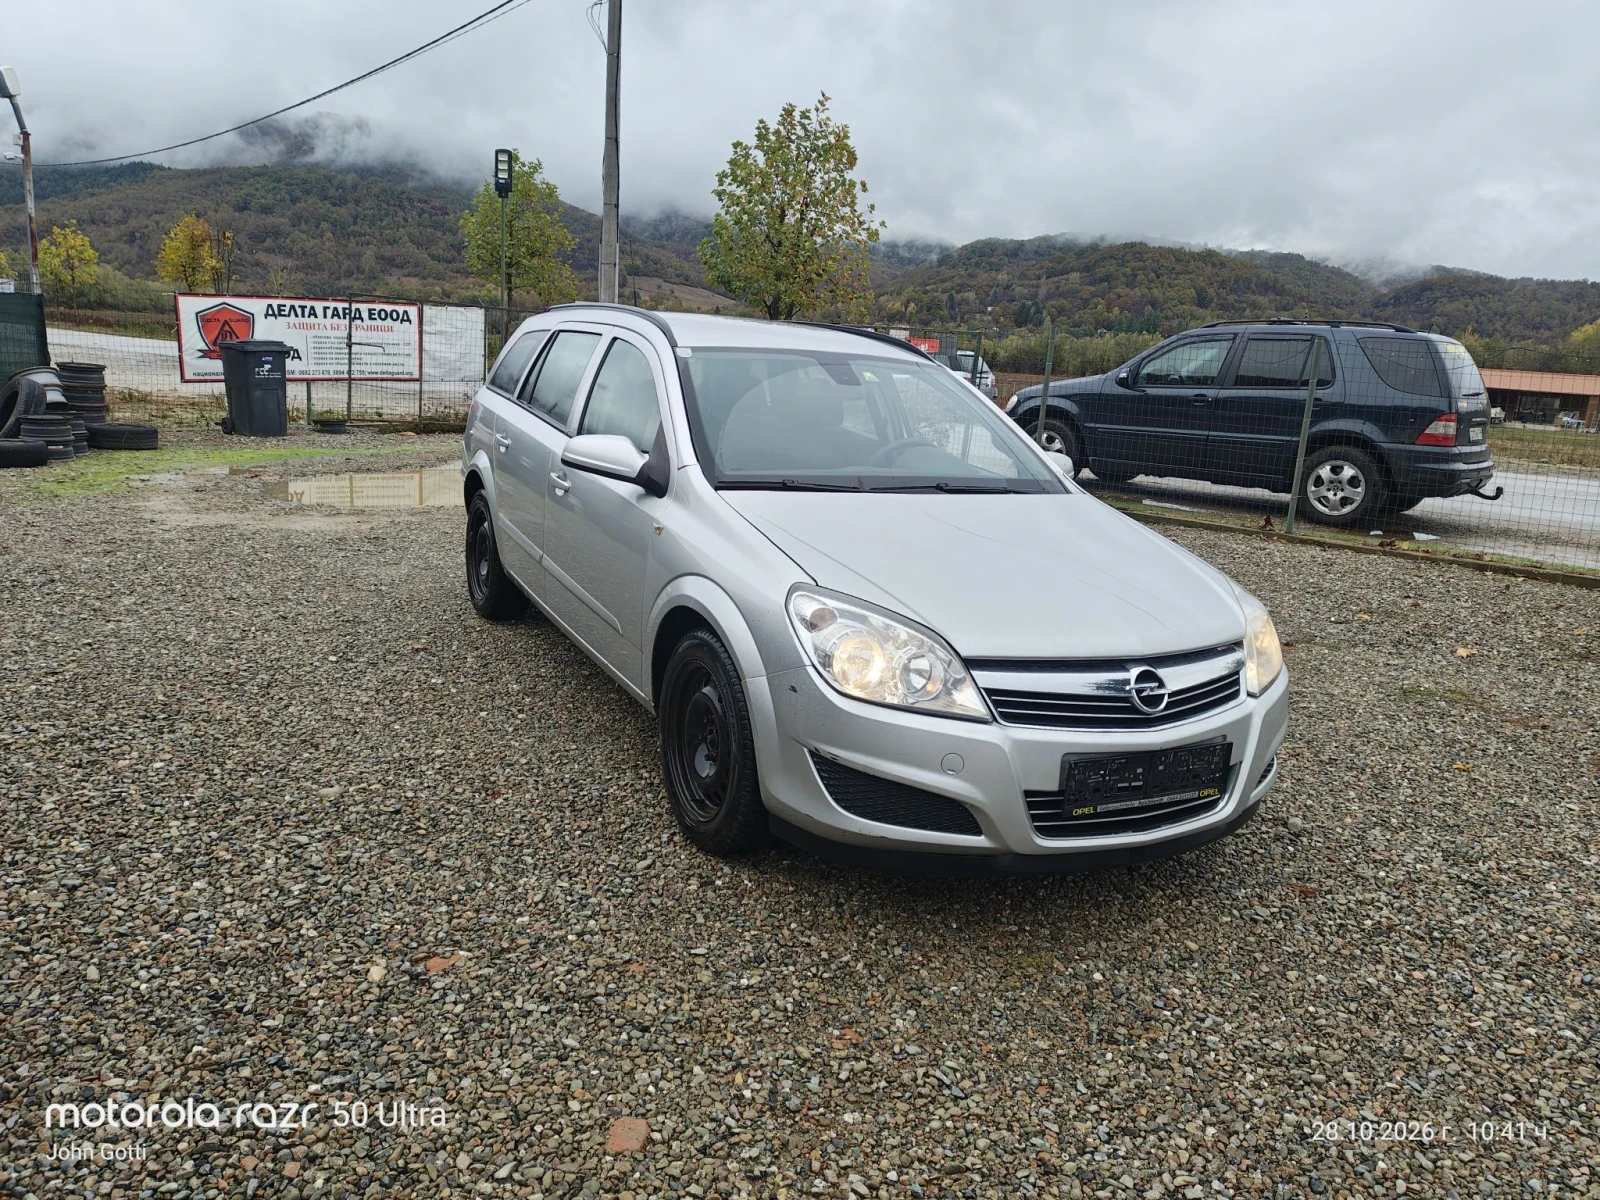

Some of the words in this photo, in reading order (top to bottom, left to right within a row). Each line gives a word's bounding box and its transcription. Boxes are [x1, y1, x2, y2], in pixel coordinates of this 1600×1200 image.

[264, 303, 318, 320] ДЕЛТА
[323, 306, 364, 322] ГАРД
[368, 308, 412, 325] ЕООД
[285, 321, 328, 332] ЗАЩИТА
[330, 323, 348, 332] БЕЗ
[349, 323, 394, 333] РАНИЦИ
[1072, 806, 1095, 816] OPEL
[1199, 787, 1220, 798] OPEL
